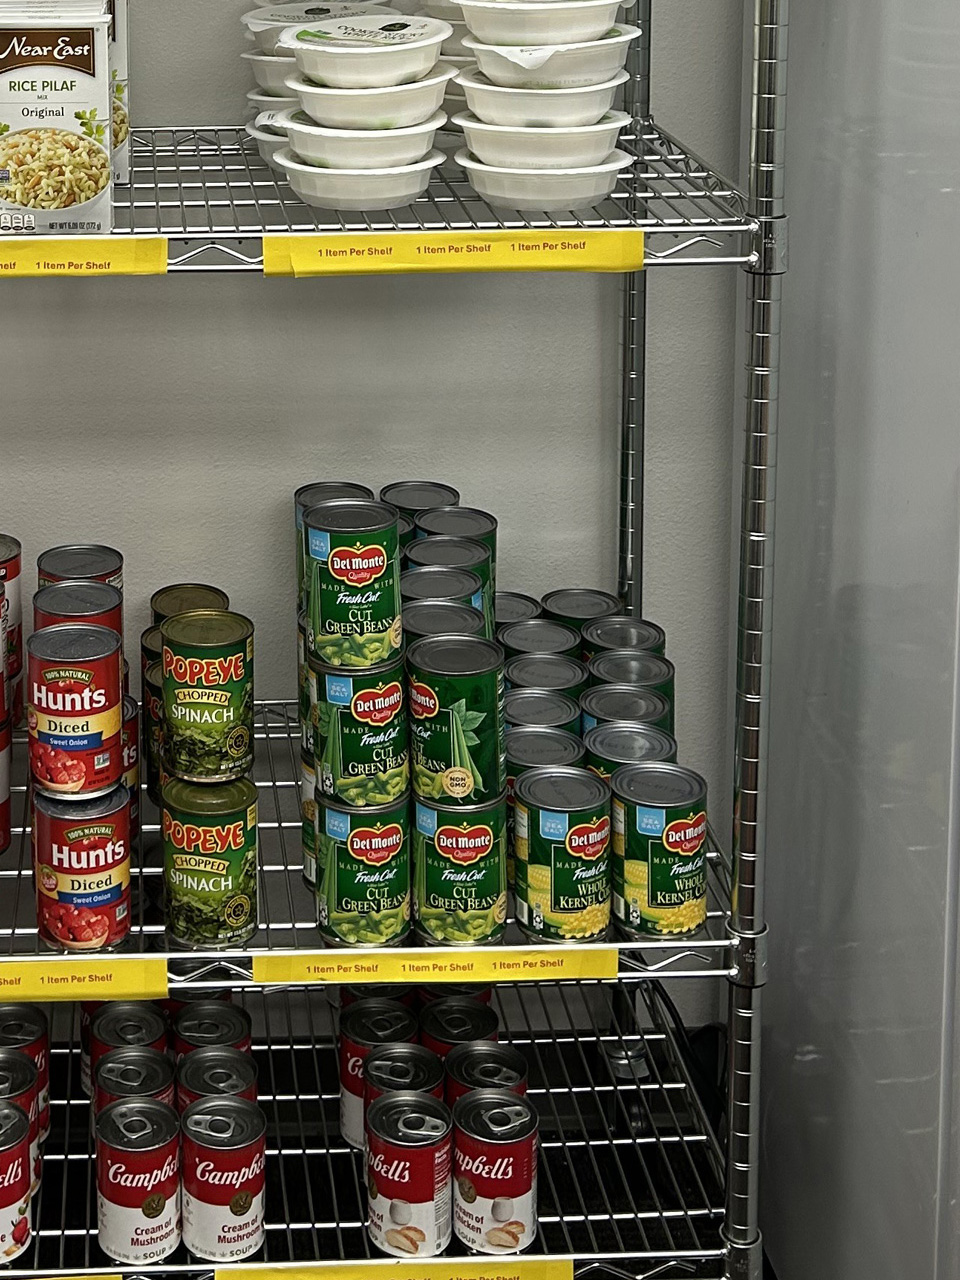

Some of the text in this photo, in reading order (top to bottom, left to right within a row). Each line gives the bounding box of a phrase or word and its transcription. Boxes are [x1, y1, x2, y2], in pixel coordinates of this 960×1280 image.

[53, 36, 90, 60] East
[9, 81, 77, 92] RICE PILAF
[21, 107, 64, 119] Original
[318, 247, 393, 257] 1 Item Per Shelf
[333, 556, 383, 569] Del Monte
[349, 610, 373, 621] CUT
[326, 620, 361, 633] GREEN
[163, 646, 245, 685] POPEYE
[176, 690, 229, 703] CHOPPED
[172, 704, 234, 723] SPINACH
[47, 720, 89, 733] Diced
[135, 1221, 172, 1236] Cream of
[131, 1228, 174, 1246] Mushroom
[143, 1248, 166, 1259] SOUP
